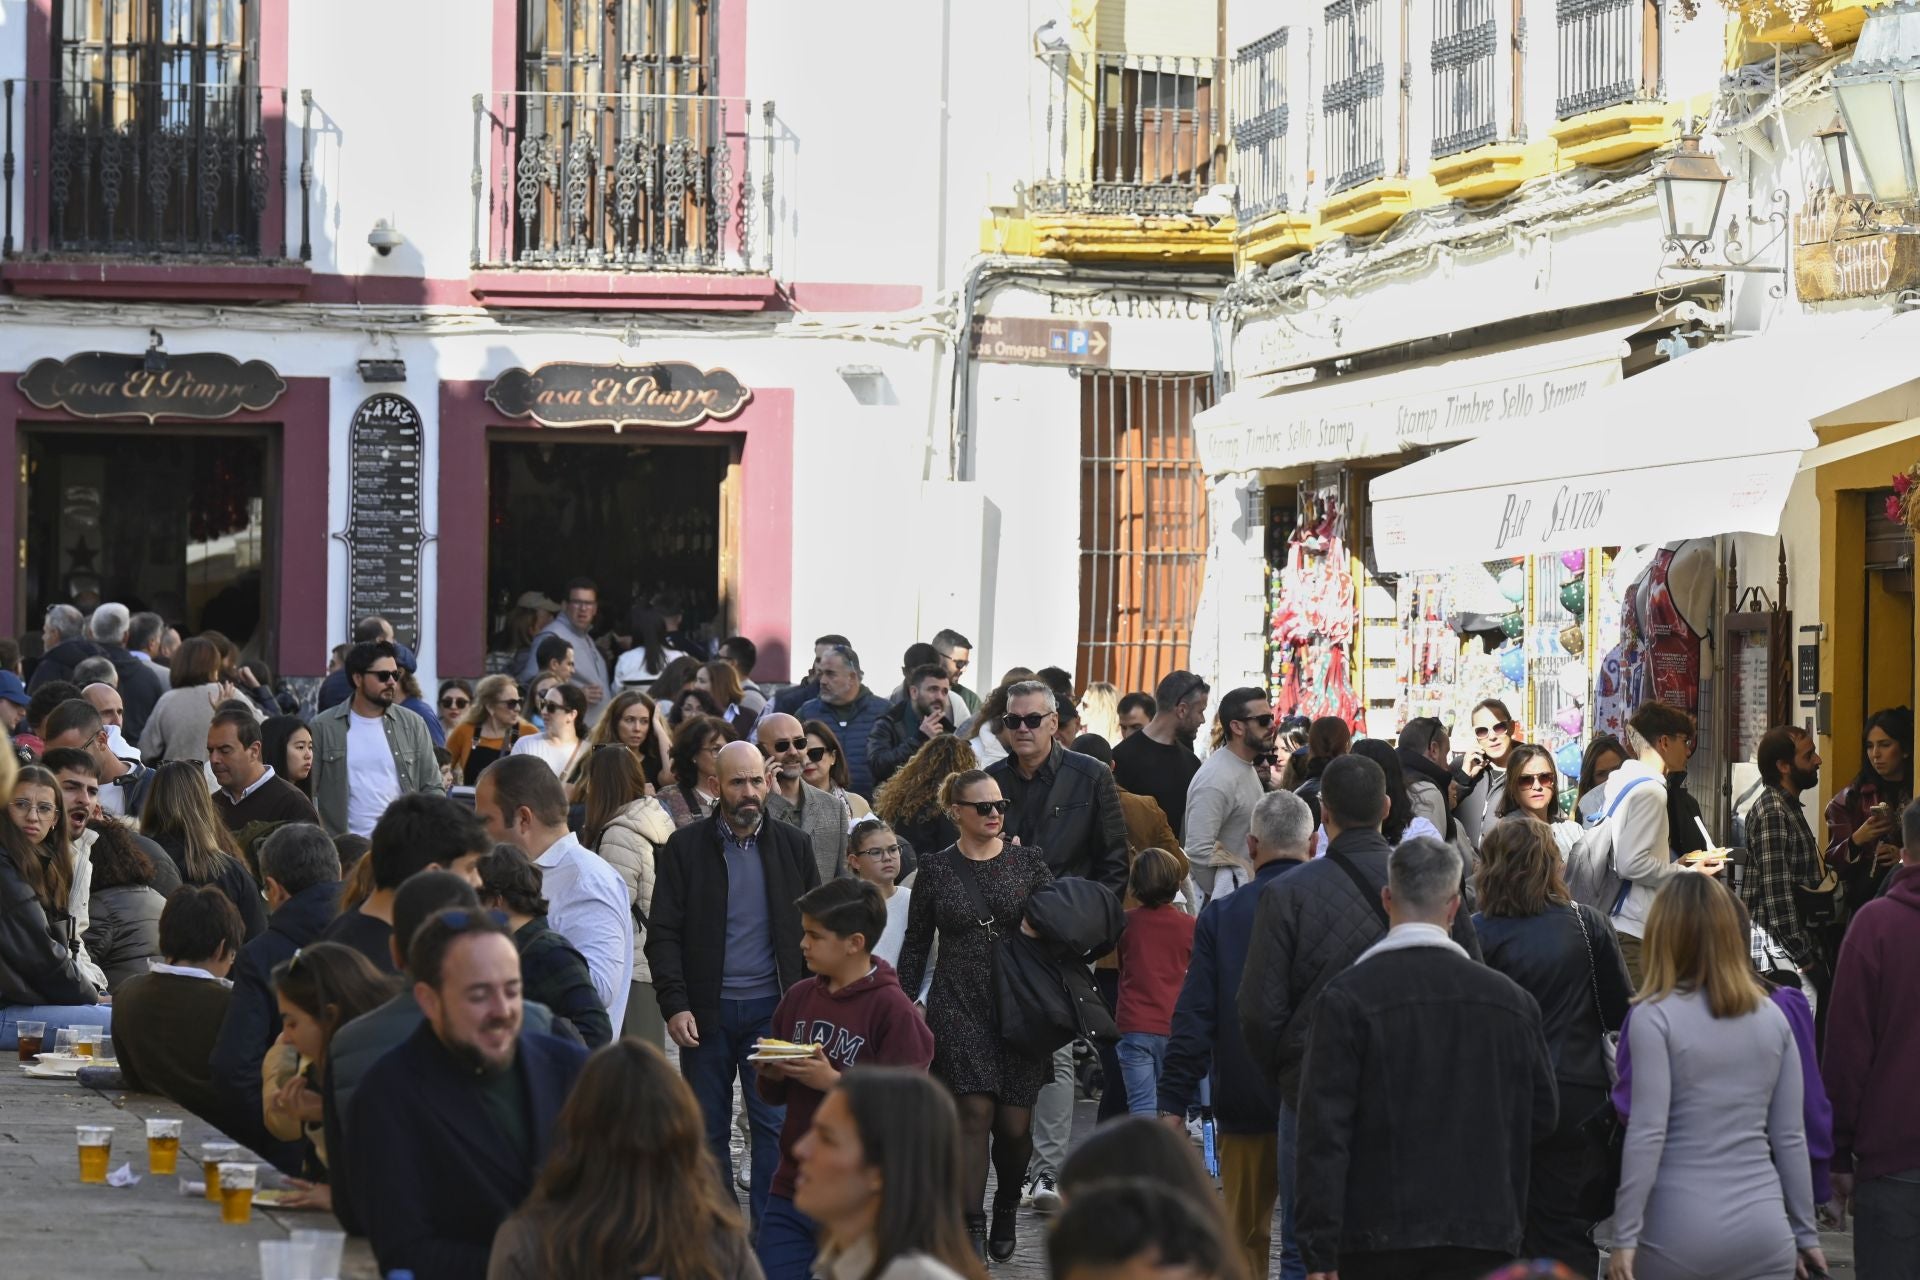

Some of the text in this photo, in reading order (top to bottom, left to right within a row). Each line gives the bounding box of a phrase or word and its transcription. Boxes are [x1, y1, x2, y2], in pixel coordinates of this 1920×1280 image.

[1836, 237, 1890, 294] SANTOS
[995, 341, 1047, 360] Omeyas
[1071, 331, 1086, 353] P
[122, 370, 156, 398] El
[588, 378, 622, 406] El
[361, 401, 413, 424] TAPAS
[1395, 403, 1438, 443] Stamp
[1445, 390, 1494, 429] Timbre
[1499, 383, 1534, 421] Sello
[1207, 417, 1355, 467] Stamp Timbre Sello Stamp
[1495, 485, 1611, 549] BAR SANTOS
